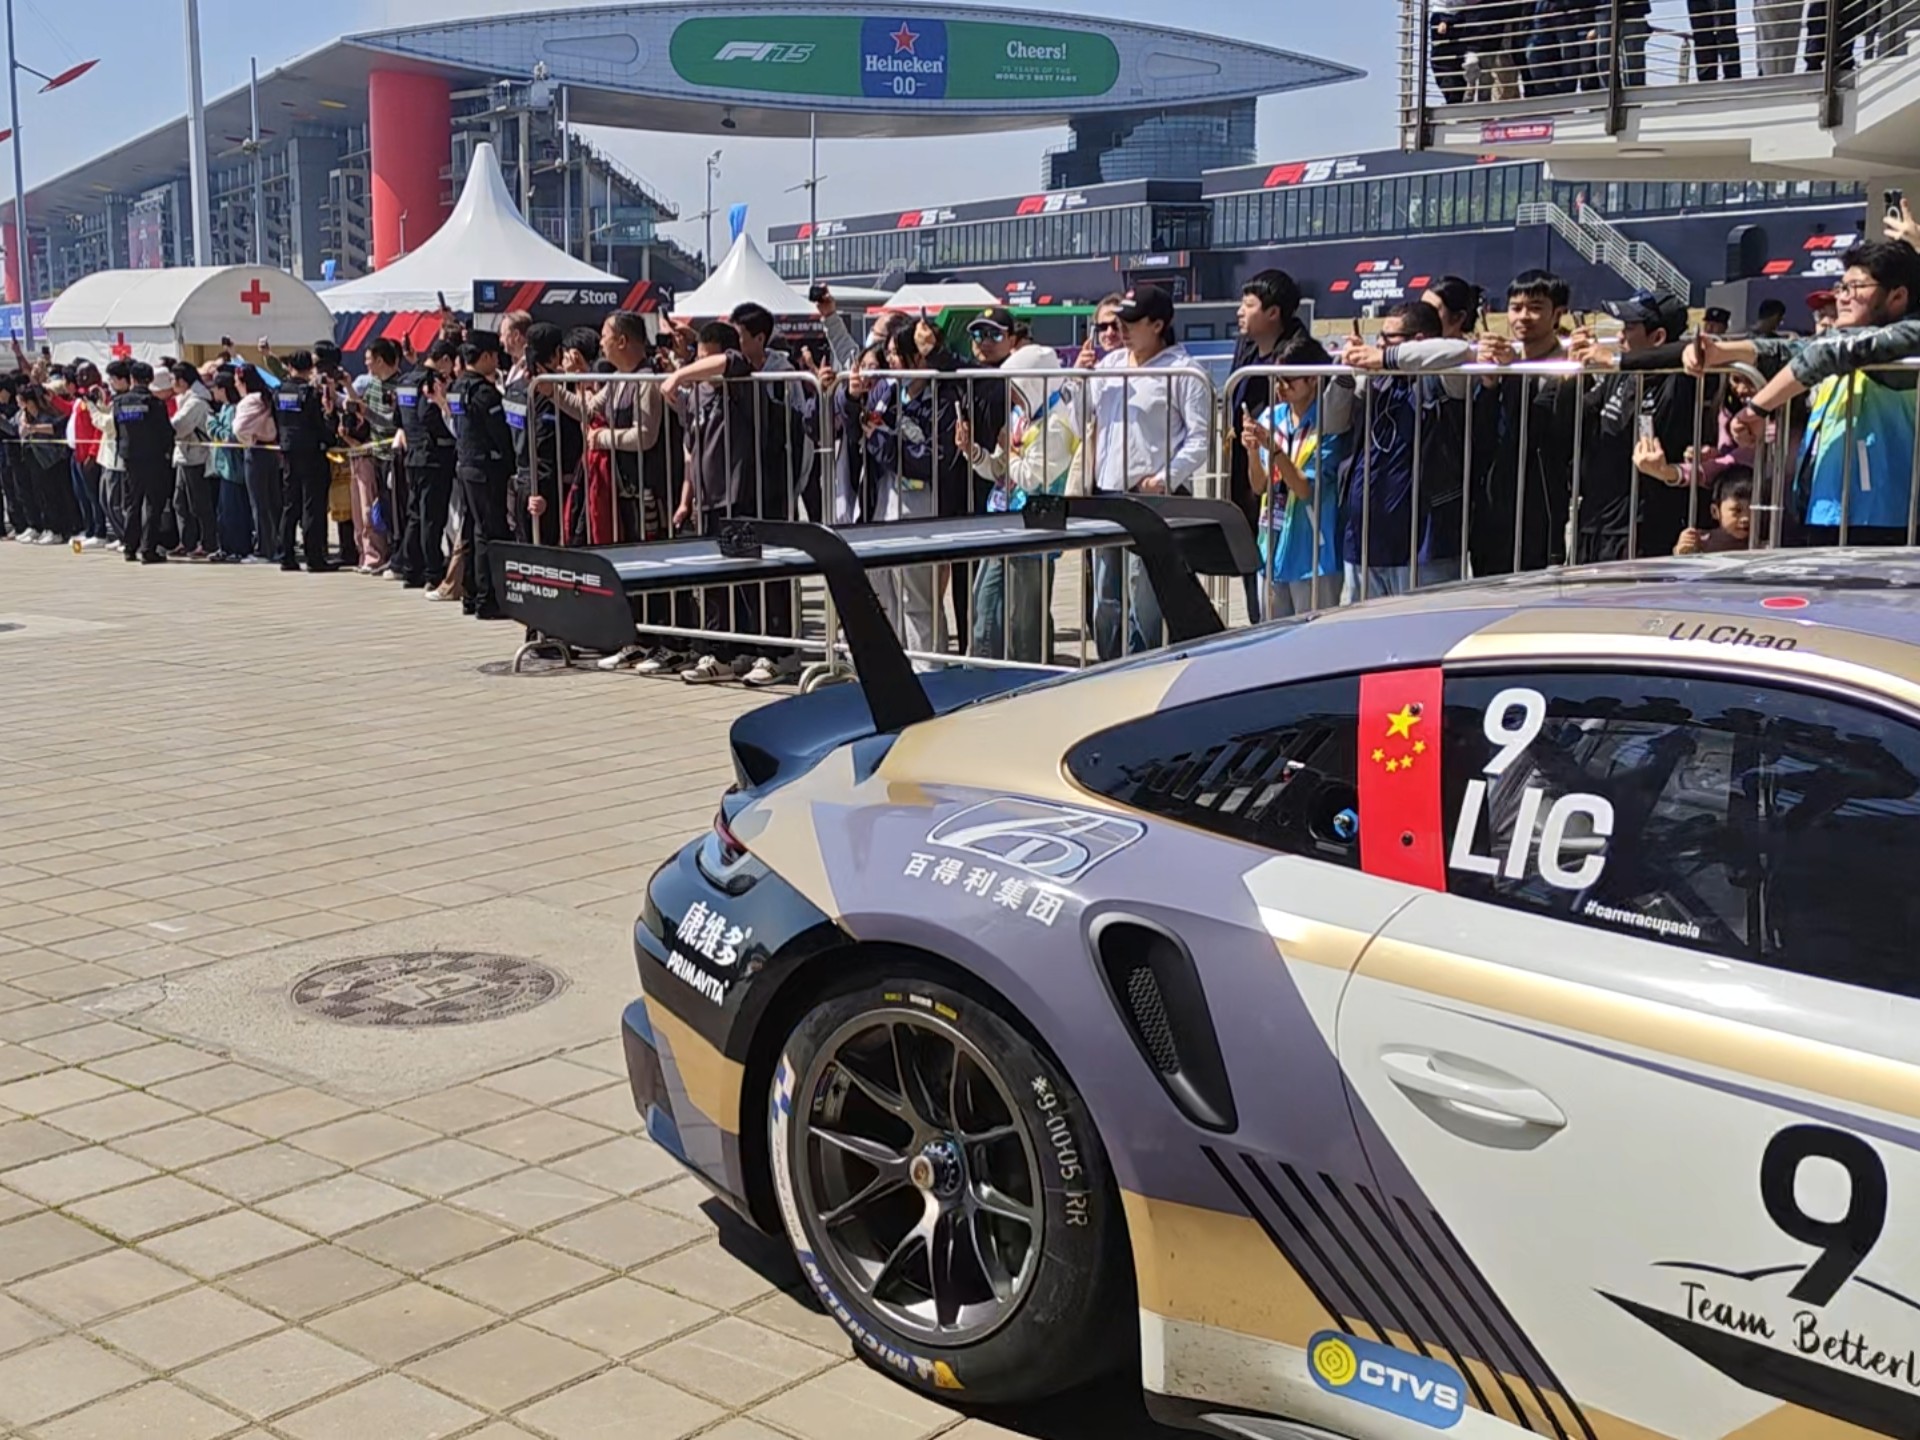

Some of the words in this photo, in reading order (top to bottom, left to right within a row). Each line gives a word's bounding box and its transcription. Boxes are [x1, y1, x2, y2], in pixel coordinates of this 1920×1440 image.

[865, 54, 943, 73] Heineken
[1006, 40, 1067, 59] Cheers!
[579, 289, 618, 305] Store
[1352, 289, 1384, 300] GRAND
[1384, 287, 1404, 299] PRIX
[505, 560, 601, 587] PORSCHE
[542, 586, 559, 599] CUP
[1669, 622, 1705, 640] LI
[1708, 625, 1797, 650] Chao
[1482, 687, 1547, 775] 9
[1449, 779, 1614, 890] LIC
[903, 852, 1064, 927] 百得利集团
[1585, 900, 1700, 939] #carreracupasia
[667, 950, 724, 1007] PRIMAVITA
[1760, 1123, 1888, 1307] 9
[805, 1261, 911, 1372] MICHELIN
[1680, 1281, 1775, 1339] Team
[1359, 1359, 1458, 1411] CTVS
